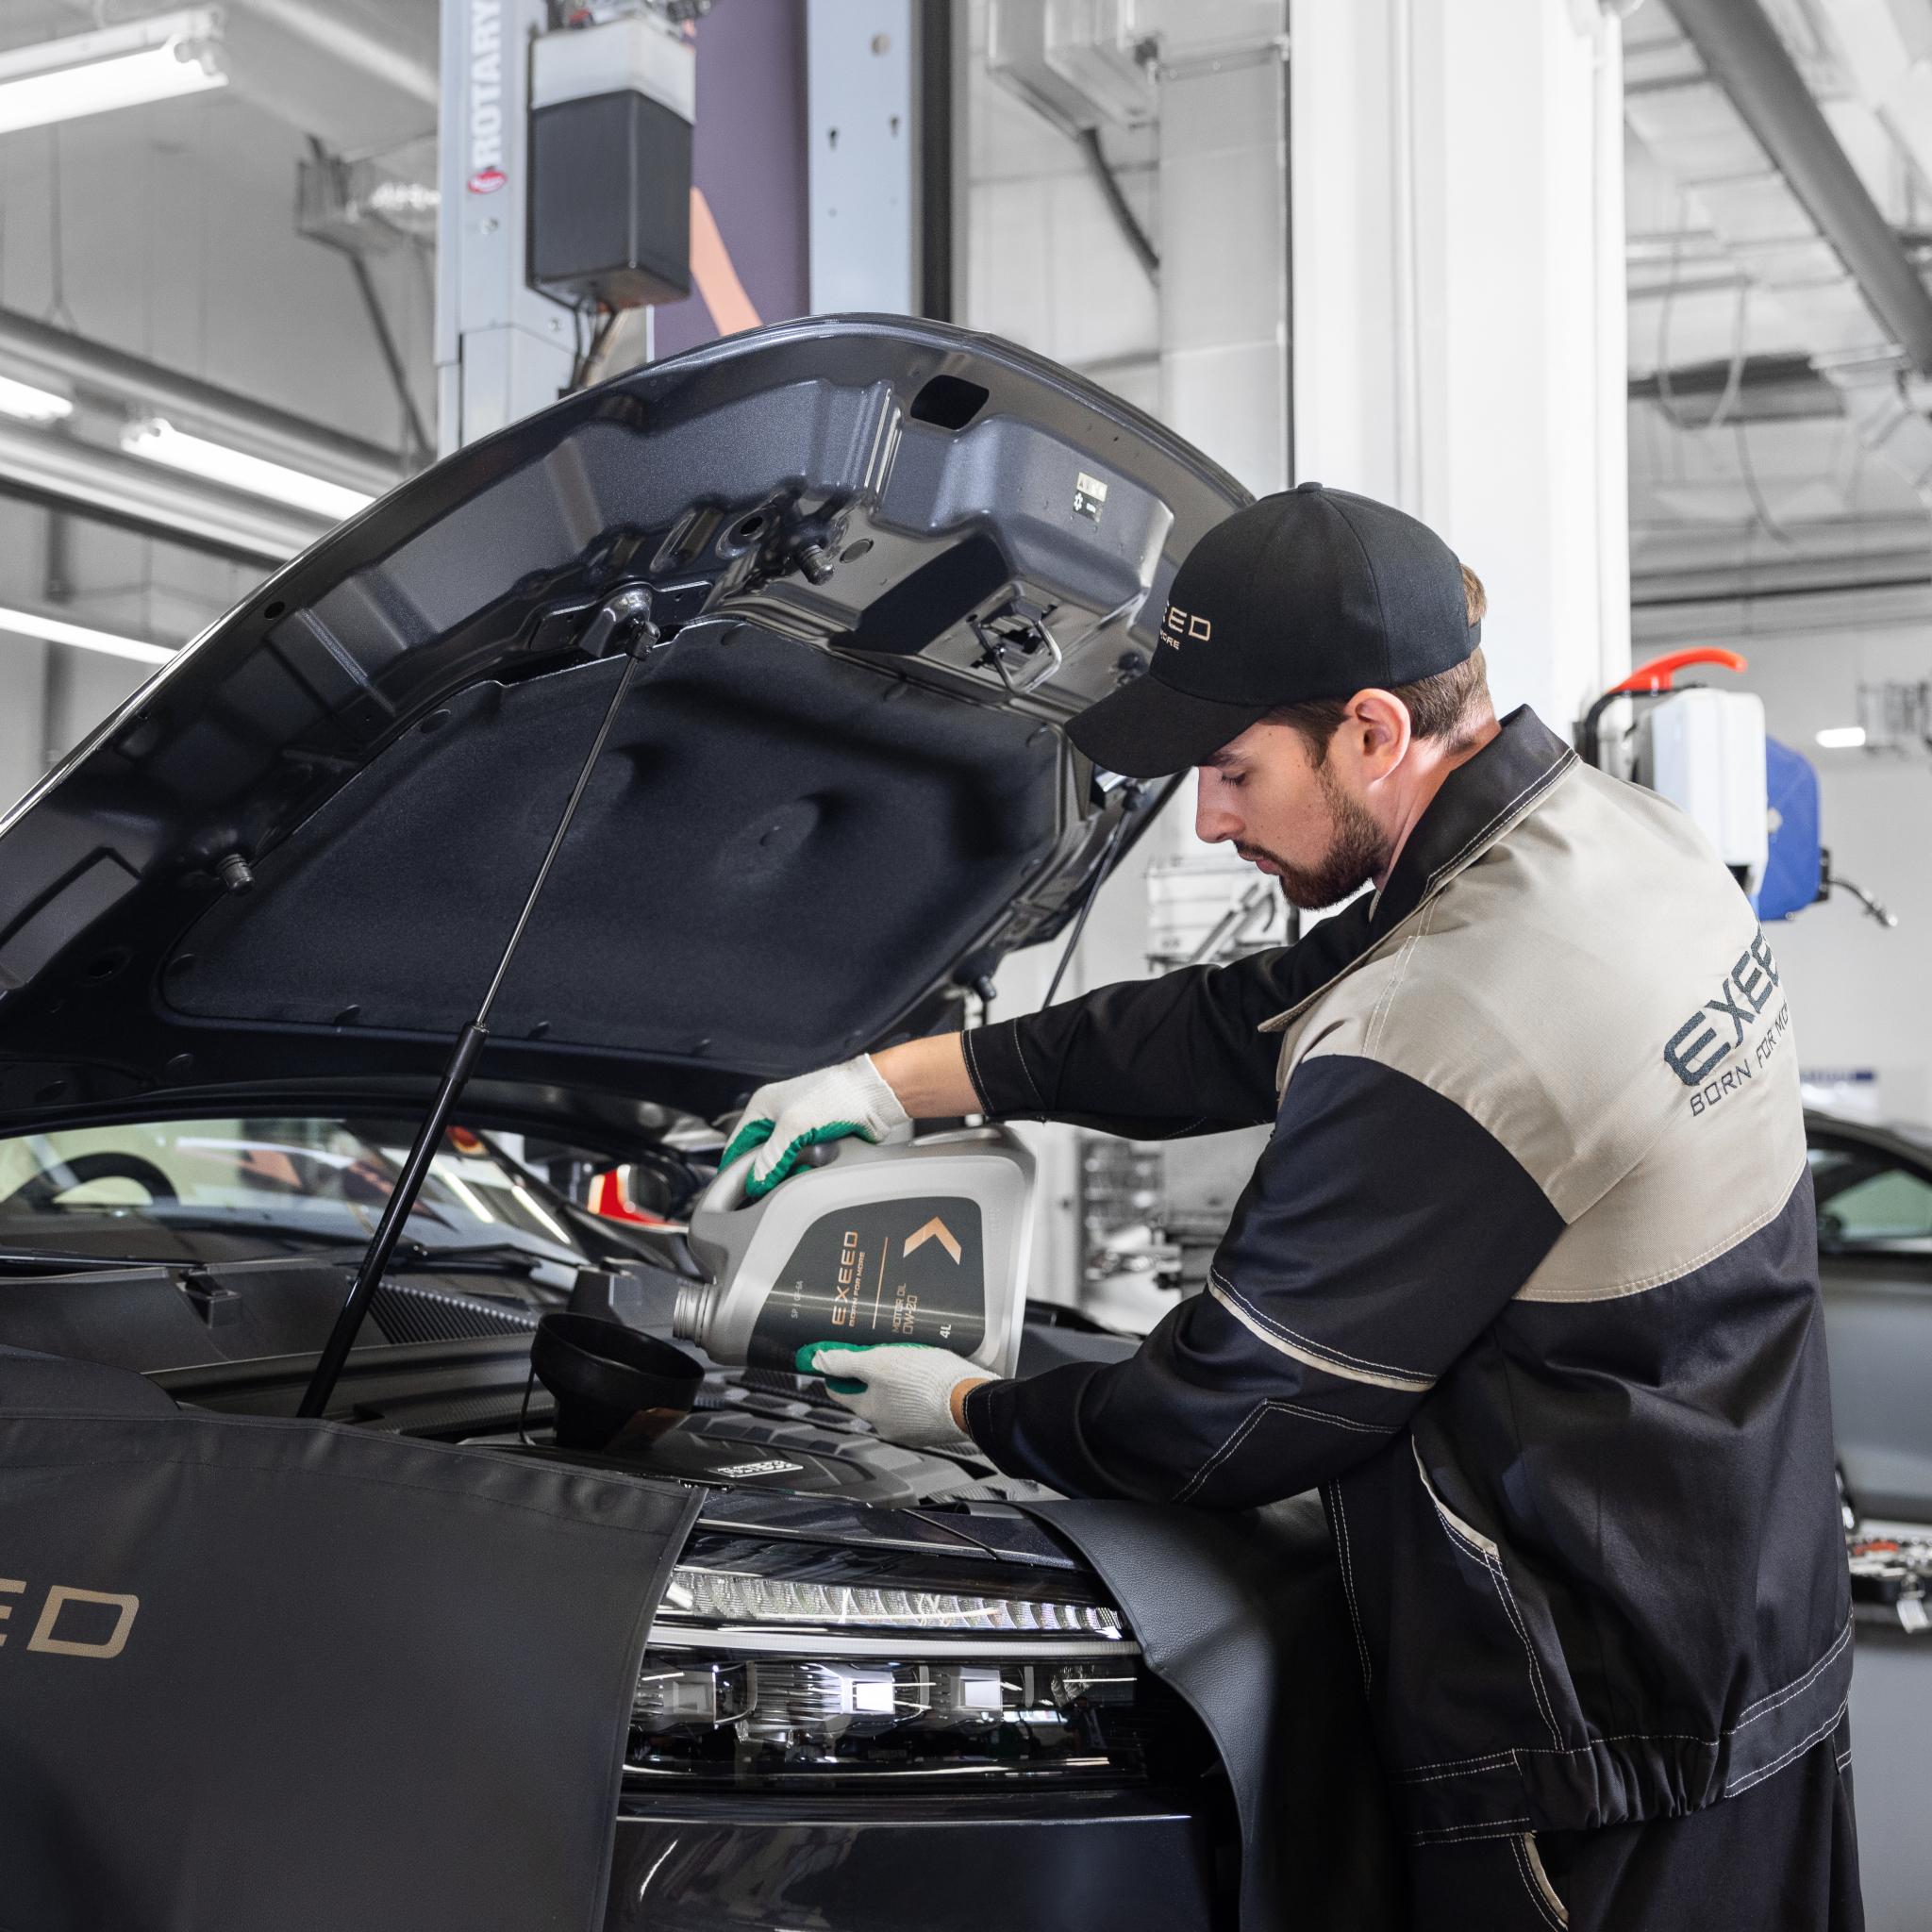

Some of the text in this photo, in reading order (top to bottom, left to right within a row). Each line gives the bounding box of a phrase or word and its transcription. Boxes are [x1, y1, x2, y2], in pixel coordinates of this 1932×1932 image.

[473, 0, 502, 169] ROTARY
[1162, 600, 1211, 641] ED
[1690, 1058, 1752, 1117] BORN
[1756, 1029, 1778, 1068] FOR
[832, 1231, 858, 1325] EXEED
[849, 1251, 866, 1327] BORN FOR MORE
[891, 1283, 907, 1333] MOTOR OIL
[940, 1324, 952, 1339] 4L
